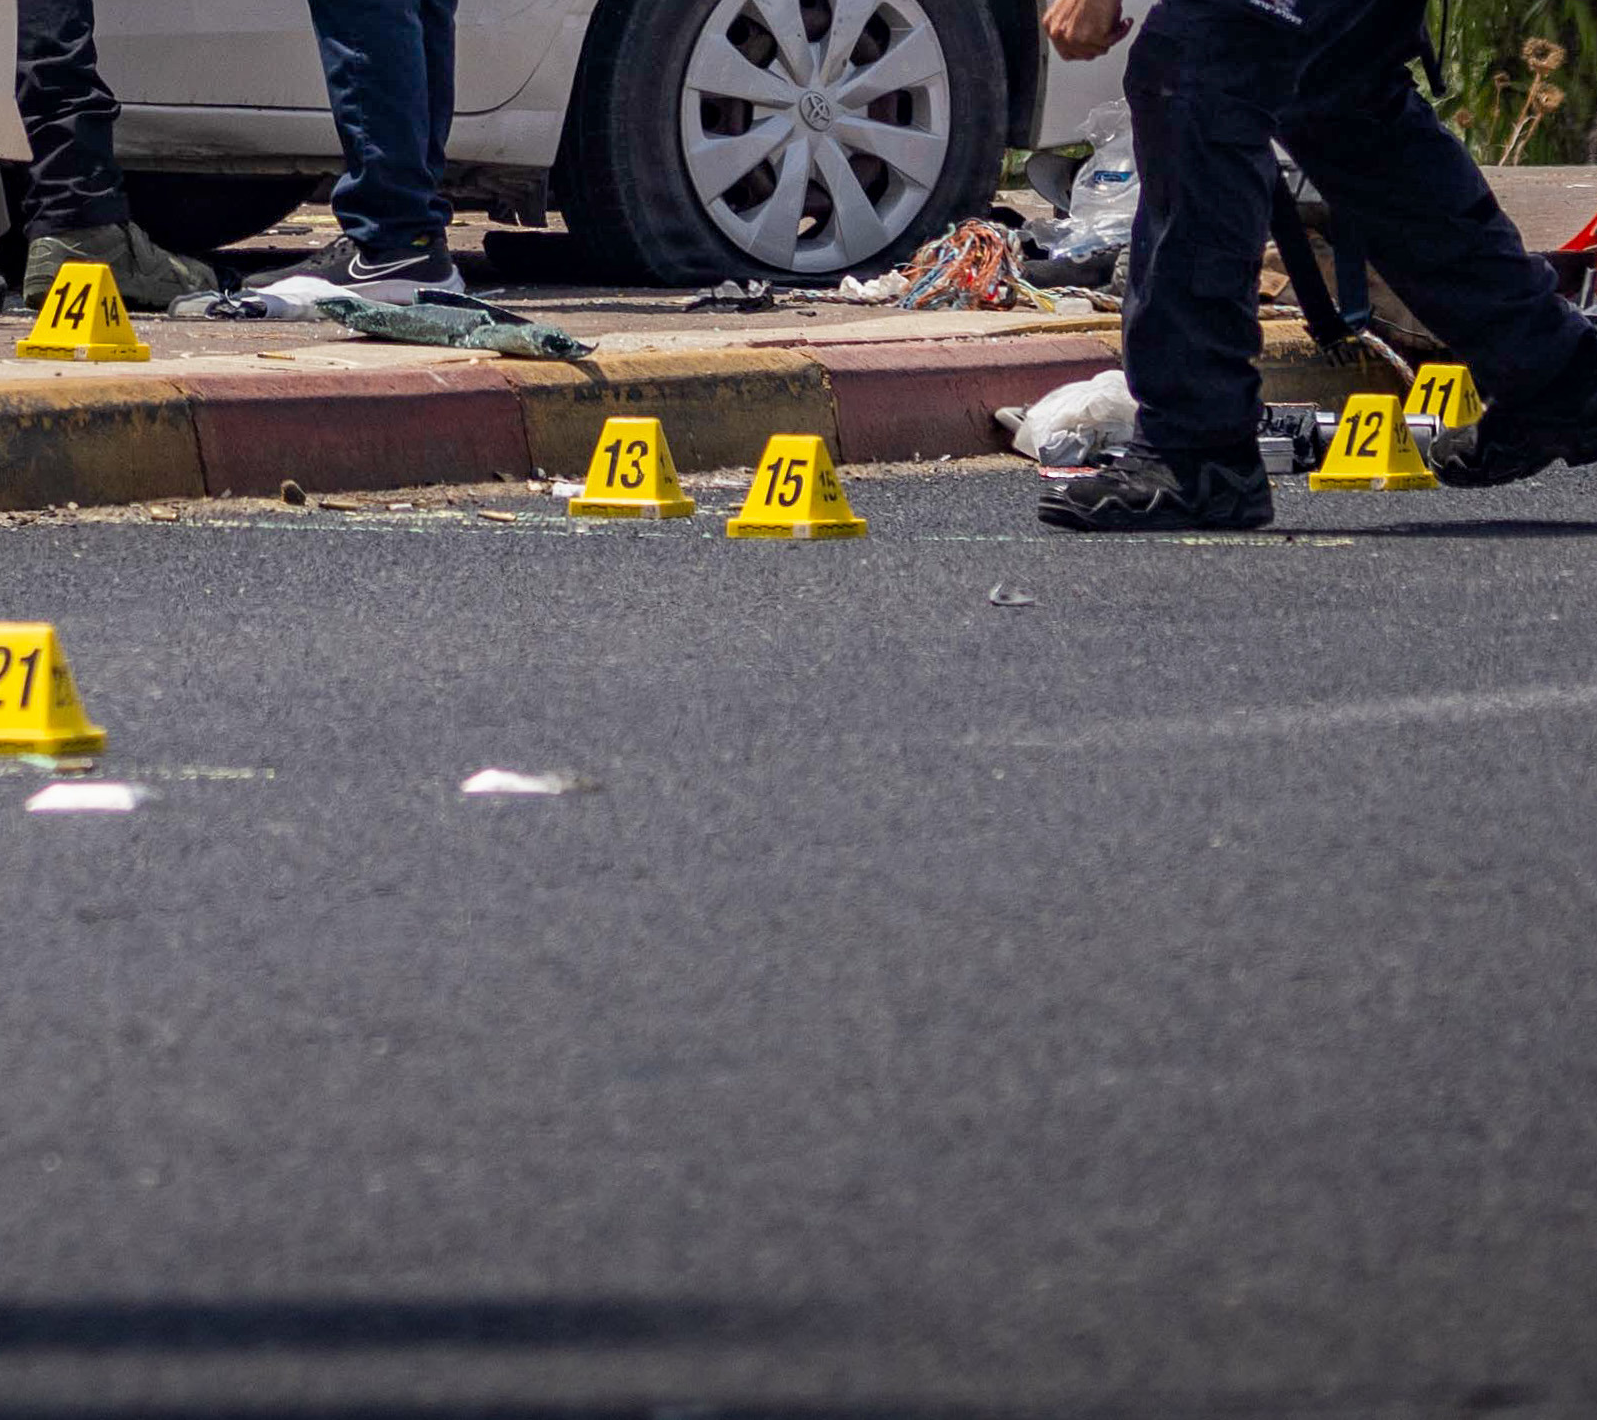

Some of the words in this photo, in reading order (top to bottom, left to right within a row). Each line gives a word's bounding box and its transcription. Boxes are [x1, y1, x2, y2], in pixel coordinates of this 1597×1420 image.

[50, 282, 92, 330] 14
[101, 295, 121, 328] 14
[1420, 377, 1455, 423] 11
[1344, 410, 1384, 457] 12
[603, 438, 649, 489] 13
[765, 457, 808, 507] 15
